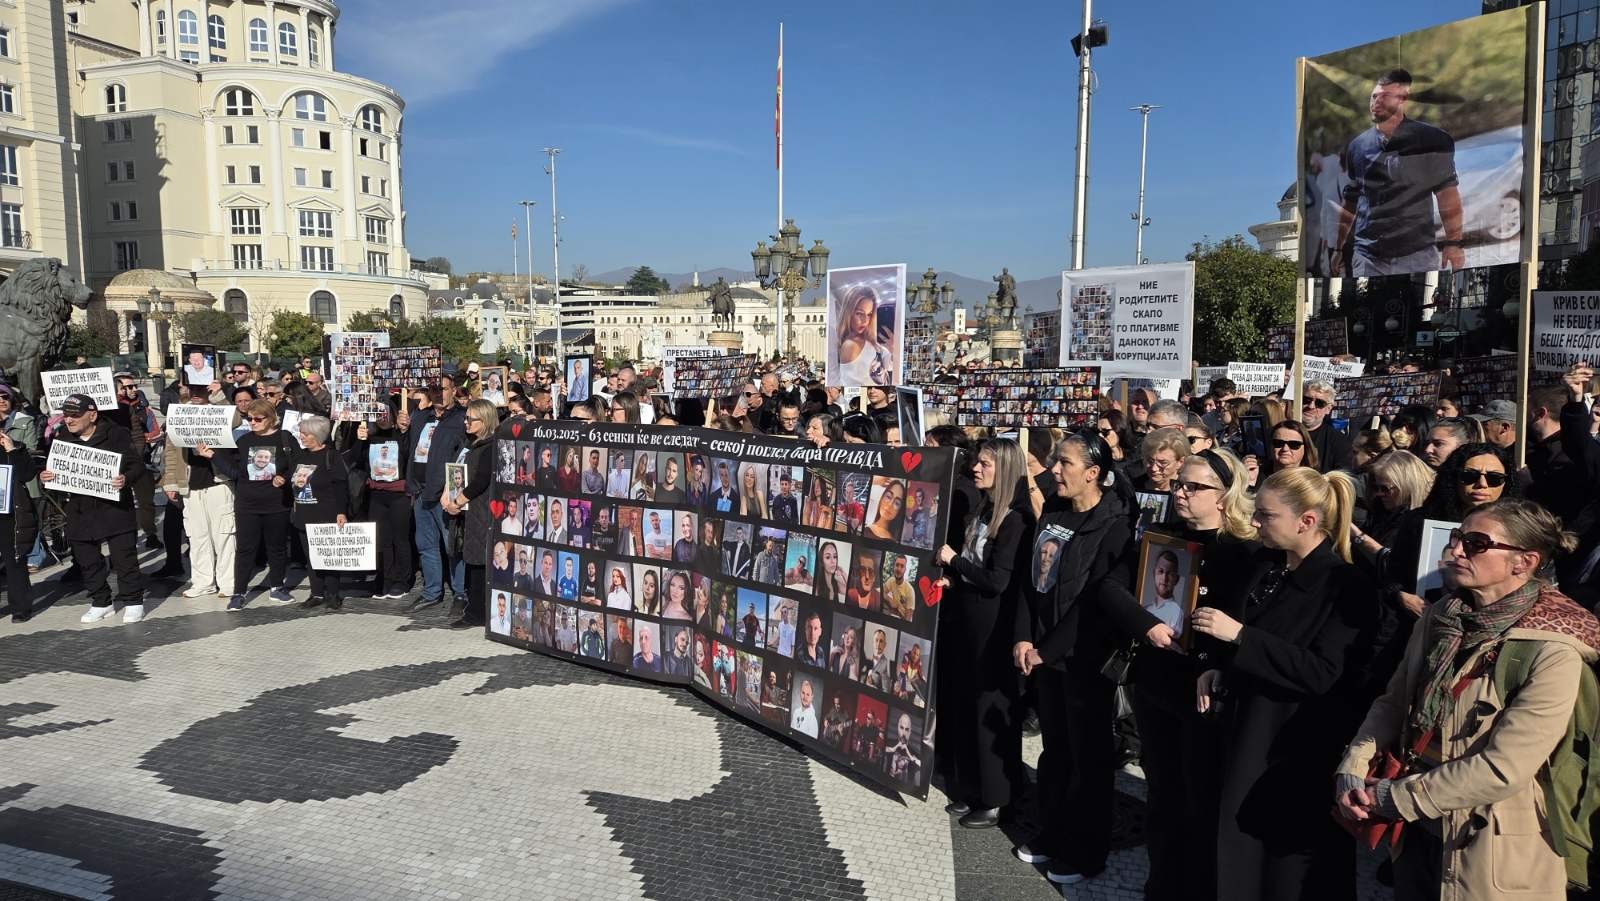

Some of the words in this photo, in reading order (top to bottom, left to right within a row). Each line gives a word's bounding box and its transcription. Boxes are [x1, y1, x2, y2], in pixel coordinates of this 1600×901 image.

[1140, 280, 1158, 290] НИЕ
[1119, 294, 1178, 306] РОДИТЕЛИТЕ
[1553, 296, 1578, 310] КРИВ
[1580, 296, 1585, 310] Е
[1132, 310, 1163, 318] СКАПО
[1553, 314, 1565, 328] НЕ
[1567, 315, 1593, 329] БЕШЕ
[1117, 324, 1127, 332] ГО
[1130, 324, 1180, 332] ПЛАТИВМЕ
[1118, 338, 1160, 347] ДАНОКОТ
[1163, 338, 1176, 346] НА
[1541, 333, 1565, 348] БЕШЕ
[1116, 352, 1179, 362] КОРУПЦИЈАТА
[1536, 352, 1567, 368] ПРАВДА
[1569, 354, 1579, 366] ЗА
[51, 374, 66, 384] МОЕТО
[68, 373, 78, 385] ДЕТЕ
[80, 373, 86, 382] НЕ
[1254, 374, 1272, 382] ЗГАСНАТ
[49, 387, 62, 397] БЕШЕ
[81, 386, 89, 395] ОД
[90, 384, 108, 394] СИСТЕМ
[174, 417, 195, 425] СЕМЕЈСТВА
[201, 417, 214, 425] ВЕЧНА
[175, 428, 191, 436] ПРАВДА
[195, 428, 222, 436] ОДГОВОРНОСТ
[533, 425, 579, 441] 16.03.2025
[589, 428, 601, 443] 63
[603, 431, 635, 444] сенки
[637, 429, 648, 444] ќе
[650, 434, 661, 445] ве
[663, 434, 700, 448] следат
[710, 439, 746, 456] секој
[746, 444, 790, 460] поглед
[791, 446, 822, 463] бара
[825, 448, 884, 469] ПРАВДА
[52, 443, 71, 456] КОЛКУ
[70, 447, 93, 461] ДЕТСКИ
[92, 451, 118, 467] ЖИВОТИ
[53, 458, 70, 471] ТРЕБА
[71, 462, 79, 473] ДА
[80, 464, 104, 478] ЗГАСНАТ
[106, 469, 112, 480] ЗА
[61, 474, 70, 486] ДА
[71, 477, 77, 487] СЕ
[320, 526, 336, 535] ЖИВОТИ
[315, 537, 335, 545] СЕМЕЈСТВА
[336, 537, 341, 545] СО
[342, 537, 356, 545] ВЕЧНА
[317, 548, 332, 556] ПРАВДА
[336, 547, 365, 556] ОДГОВОРНОСТ
[323, 559, 334, 567] НЕКА
